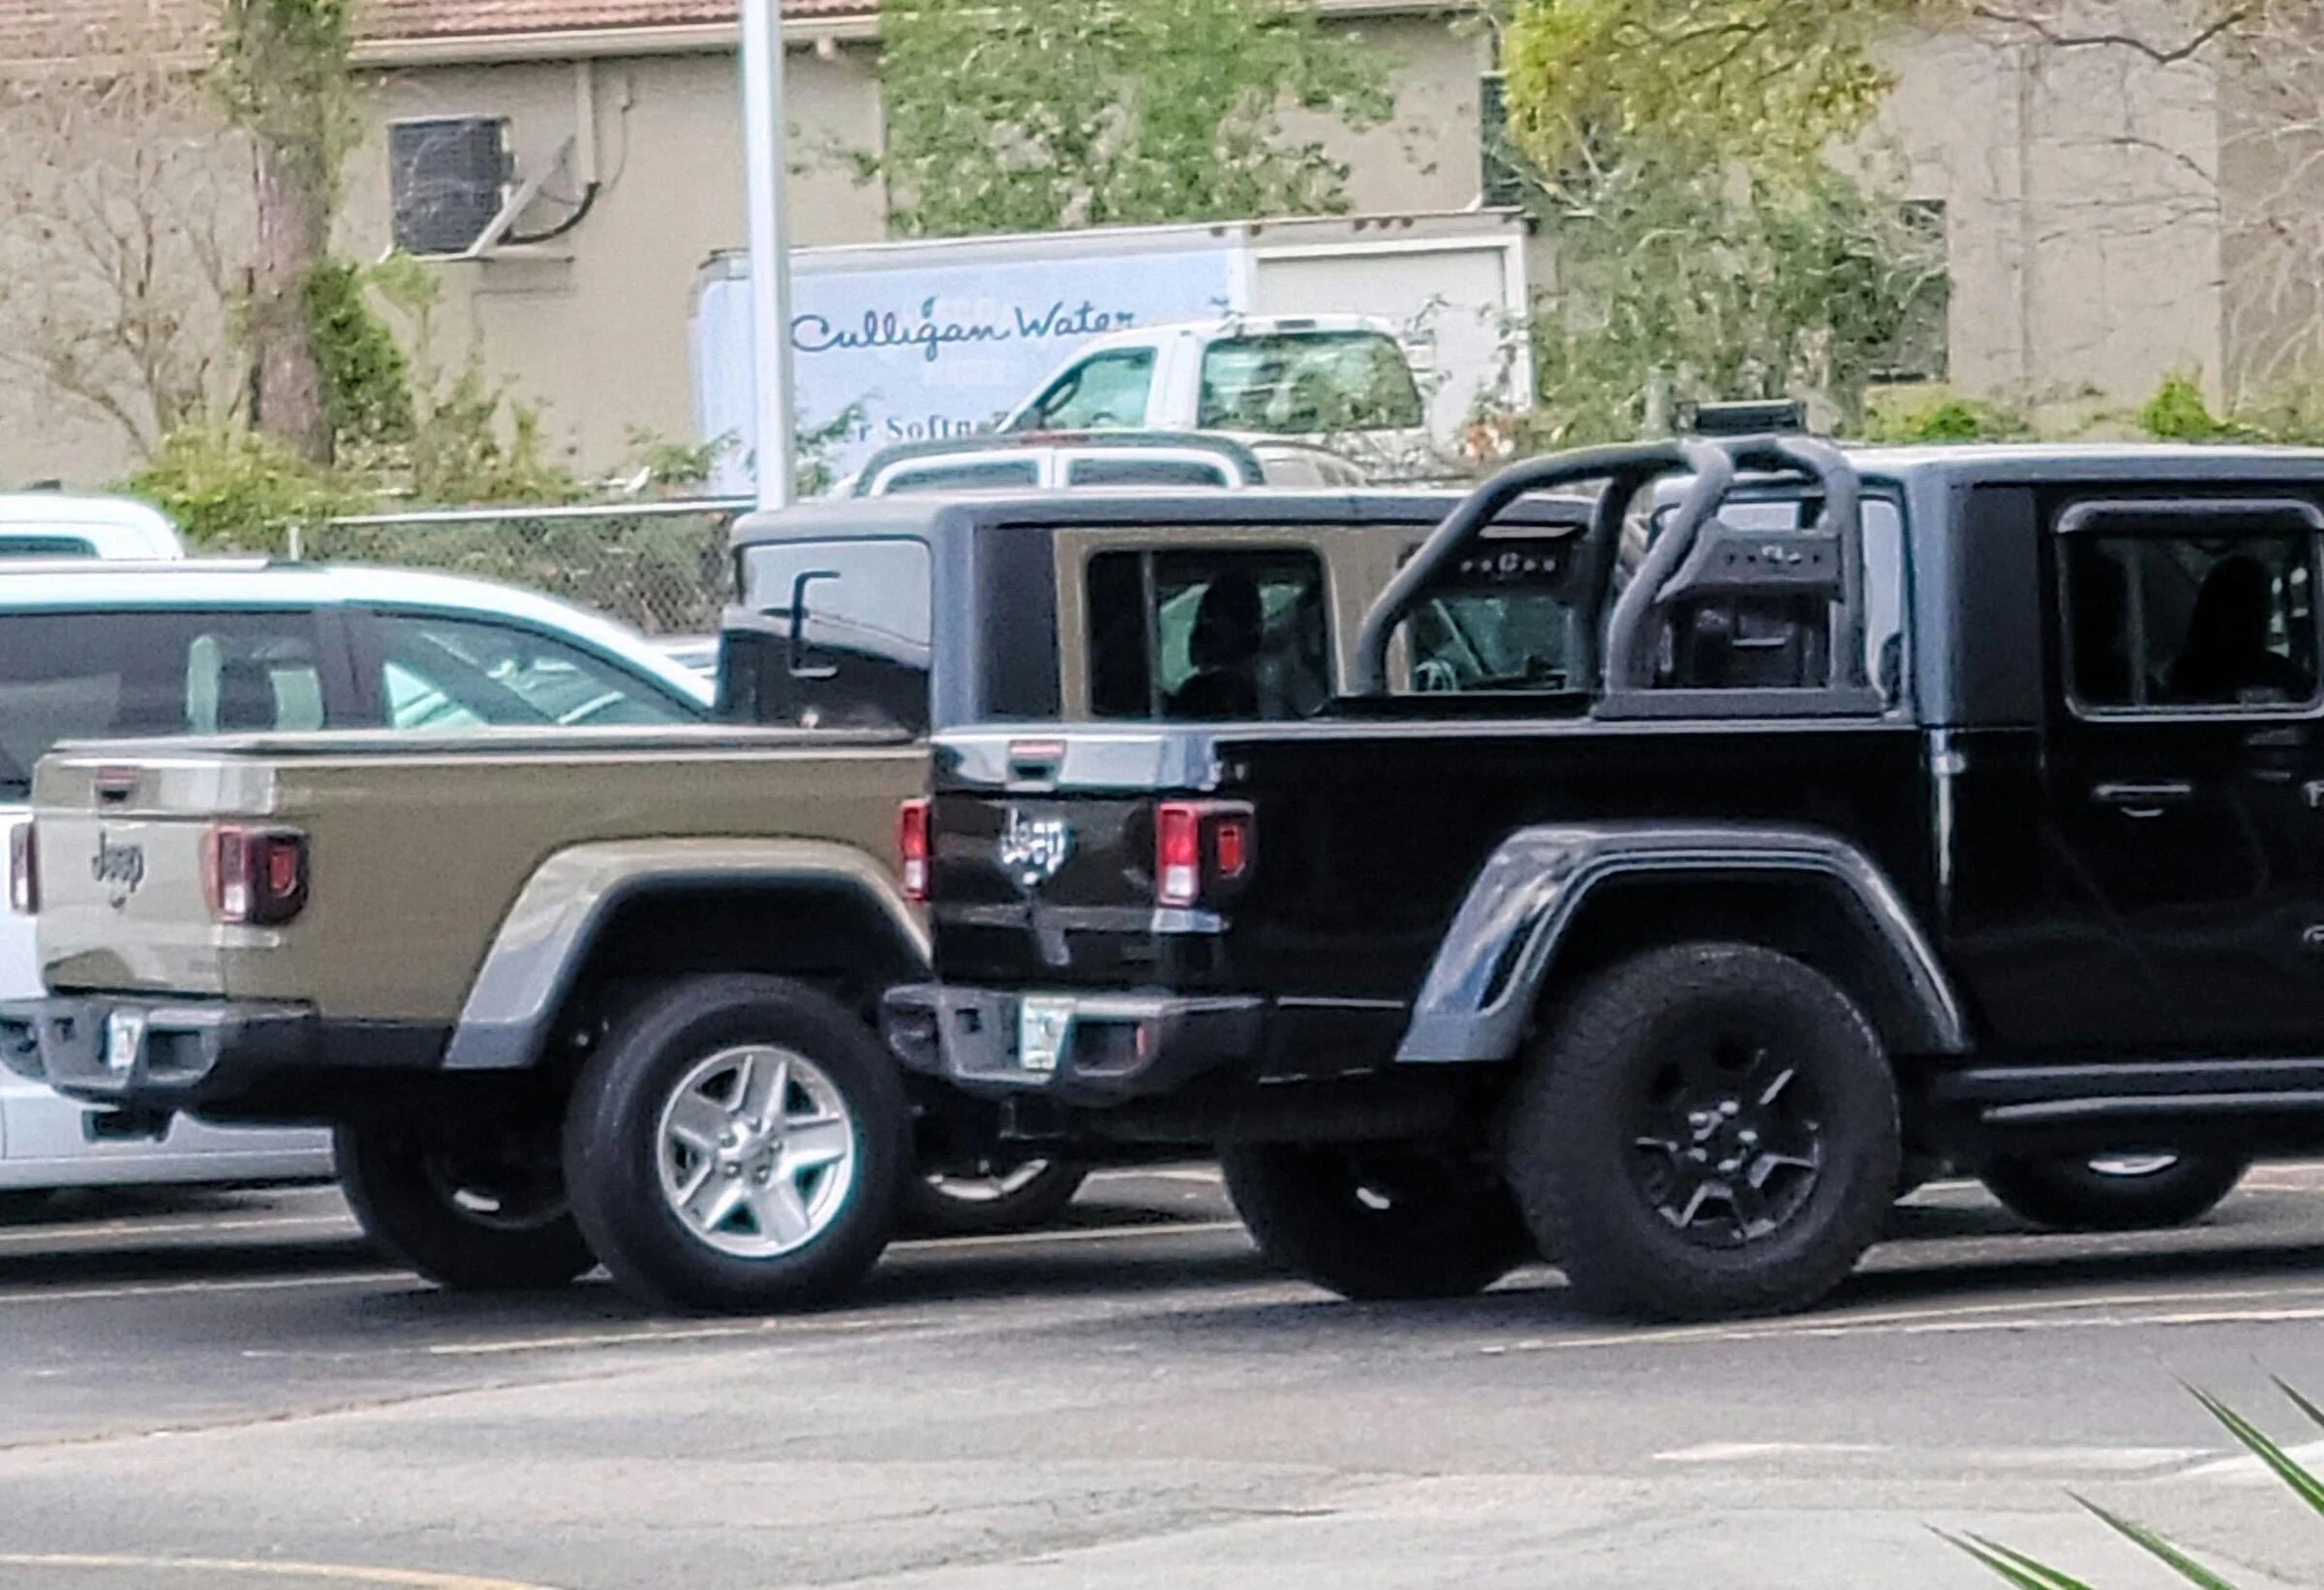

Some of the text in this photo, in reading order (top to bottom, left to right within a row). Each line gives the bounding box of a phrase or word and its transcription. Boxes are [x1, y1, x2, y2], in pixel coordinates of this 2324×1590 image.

[791, 296, 1135, 362] Culligan Water
[887, 413, 972, 439] Softn
